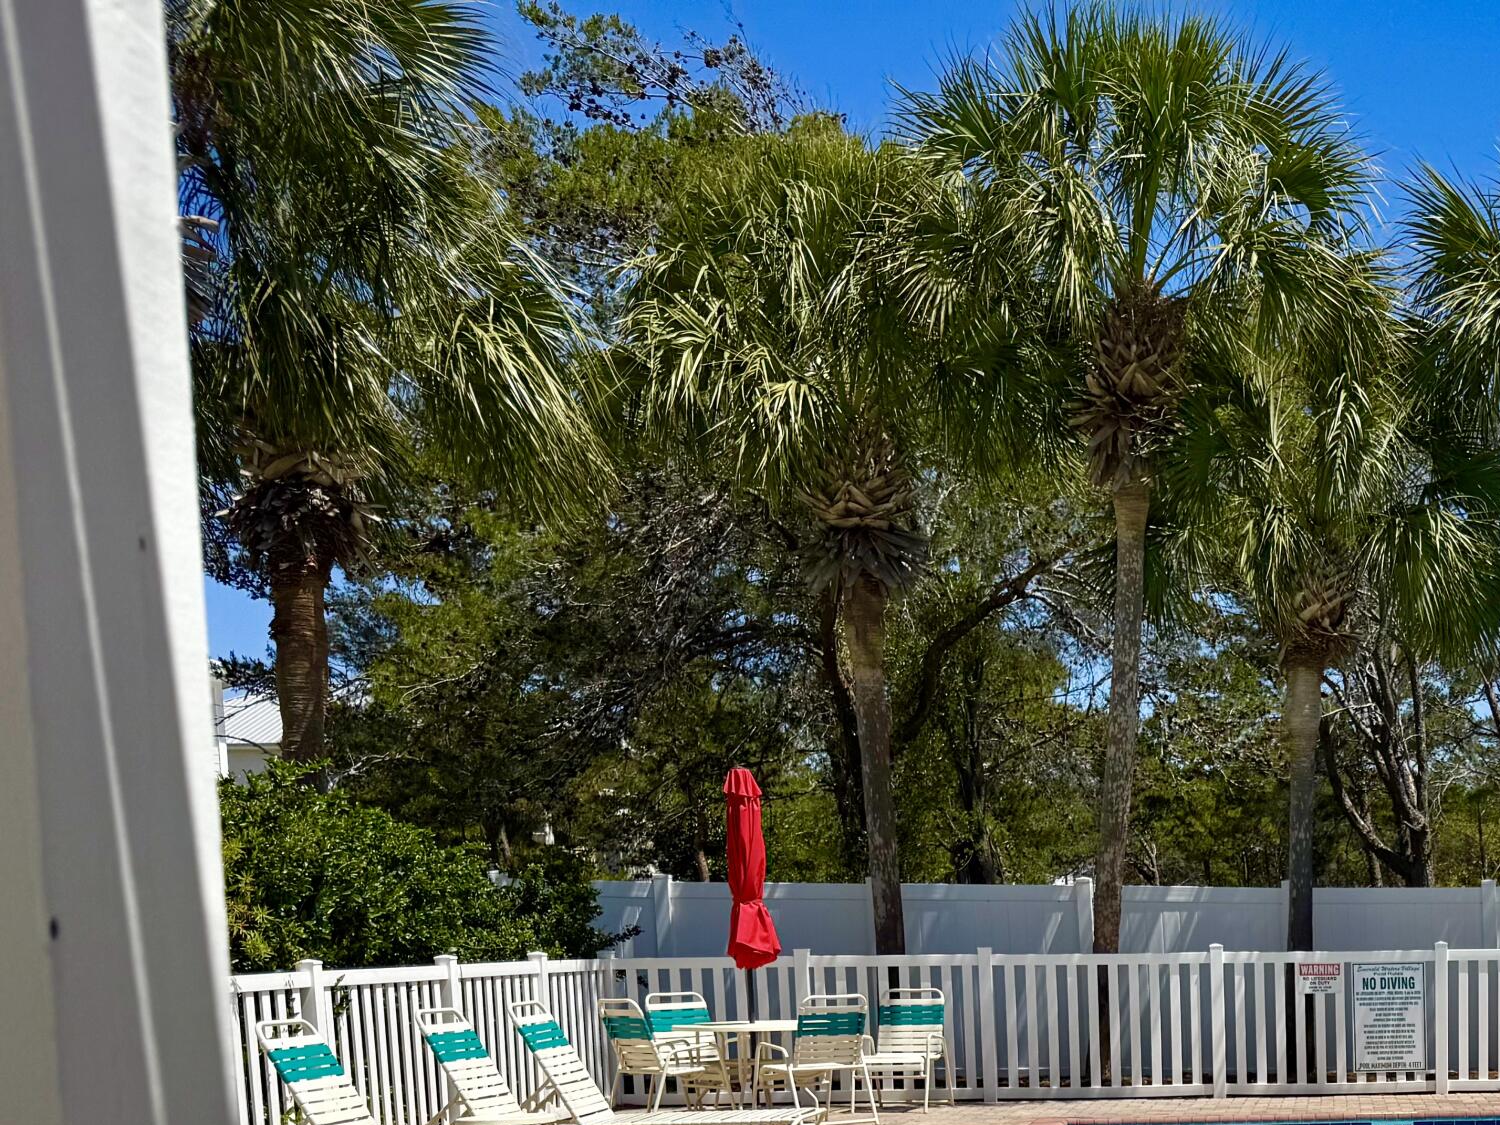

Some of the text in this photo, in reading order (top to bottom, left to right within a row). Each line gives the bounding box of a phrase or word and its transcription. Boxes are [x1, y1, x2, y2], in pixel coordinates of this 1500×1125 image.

[1301, 964, 1340, 975] WARNING
[1362, 976, 1415, 990] NO DIVING
